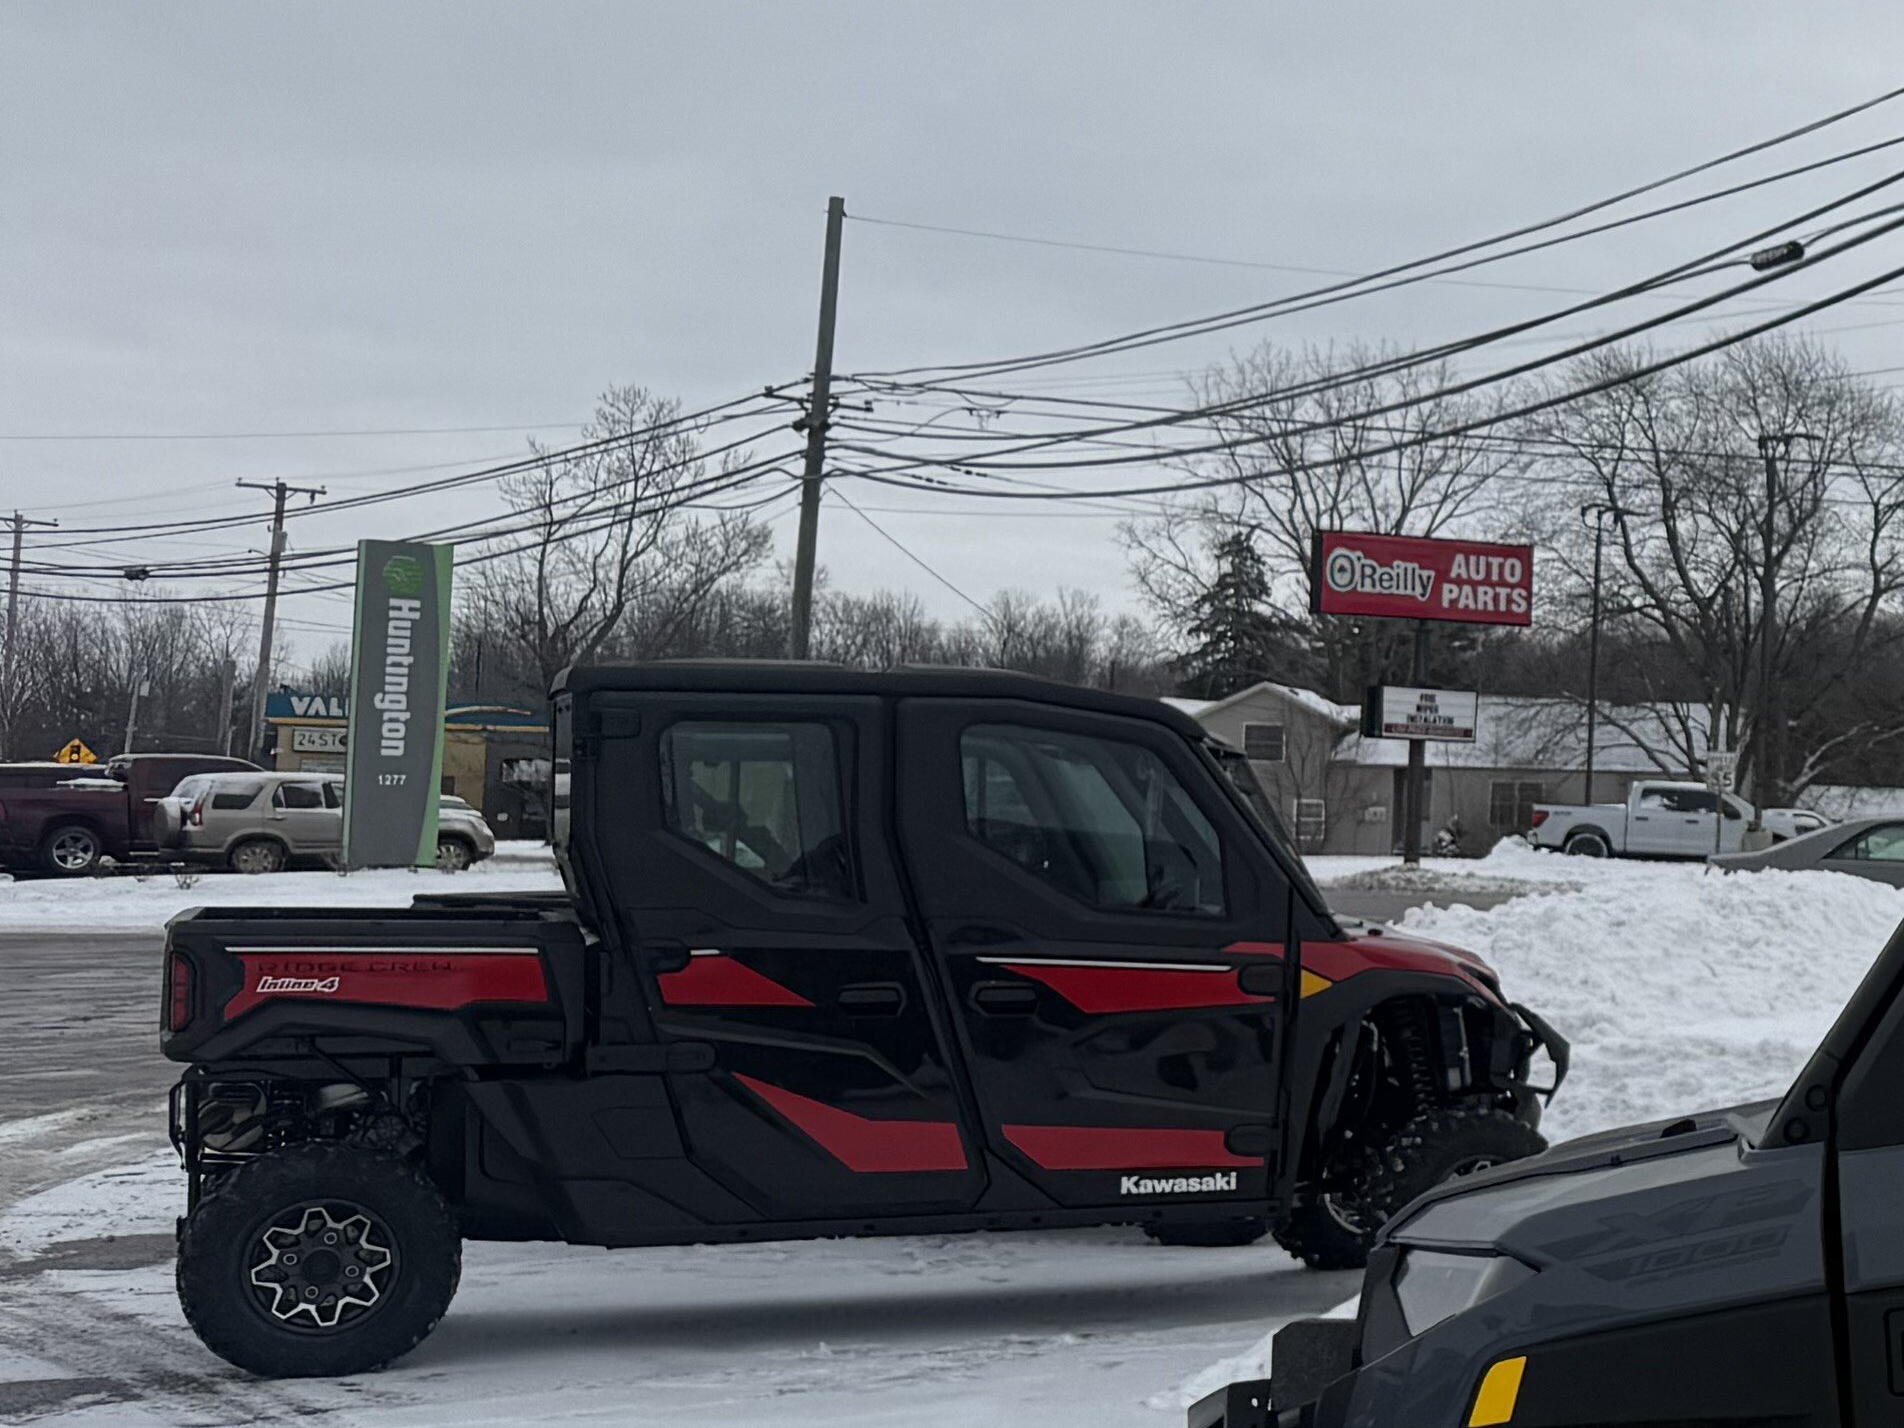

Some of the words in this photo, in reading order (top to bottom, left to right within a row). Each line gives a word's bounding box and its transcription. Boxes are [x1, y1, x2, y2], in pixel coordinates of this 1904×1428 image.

[1329, 551, 1433, 599] O'Reilly
[1450, 553, 1523, 584] AUTO
[1441, 583, 1528, 614] PARTS
[373, 597, 422, 757] Huntington
[377, 774, 407, 786] 1277
[258, 961, 359, 973] RIDGE
[317, 976, 340, 992] 4
[1120, 1171, 1238, 1195] Kawasaki
[1629, 1224, 1796, 1277] 1000
